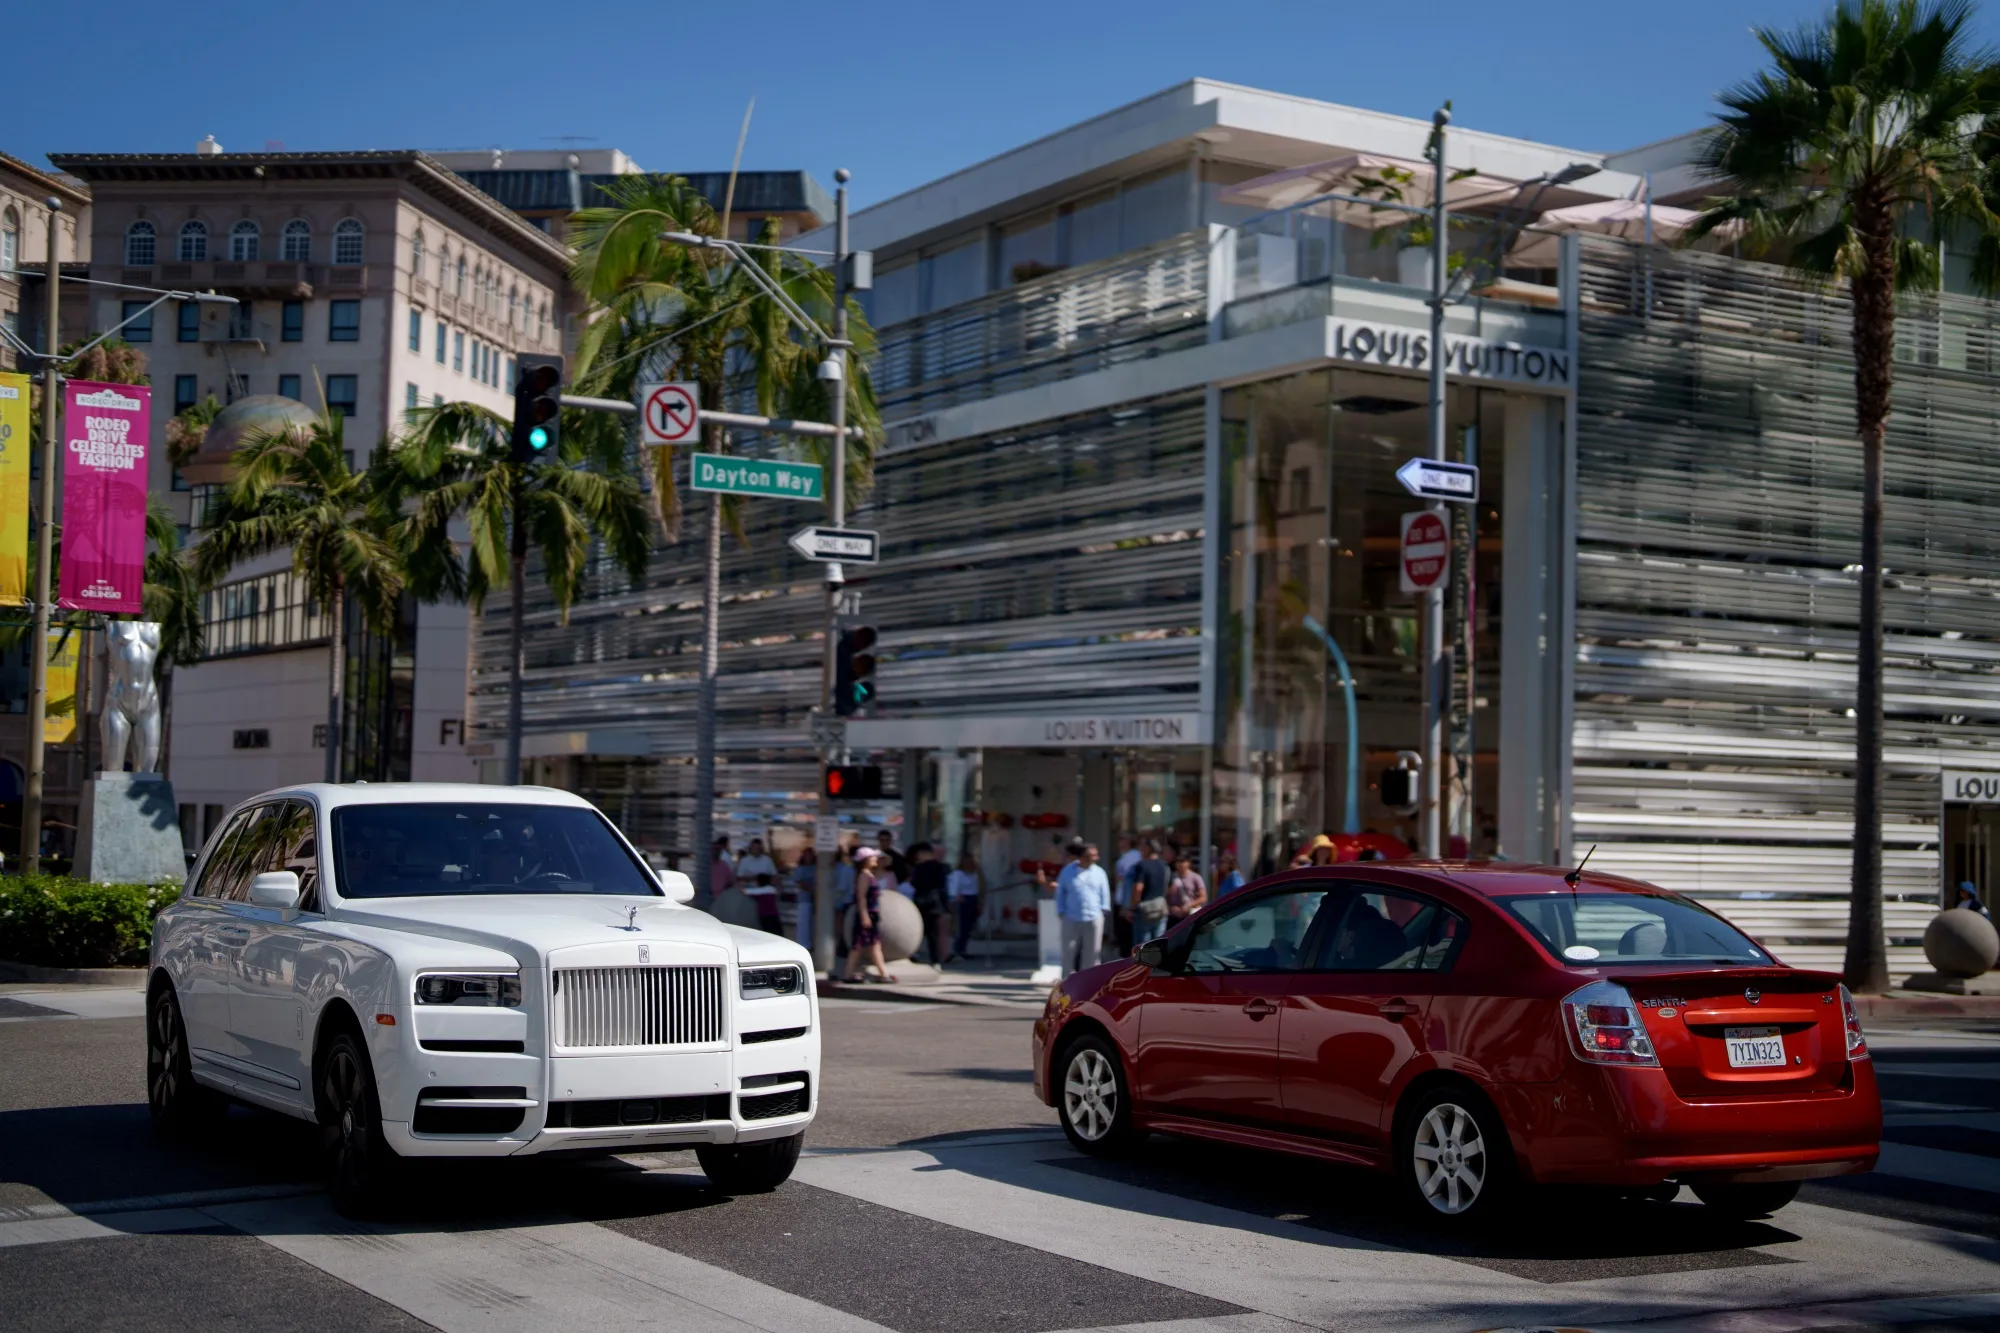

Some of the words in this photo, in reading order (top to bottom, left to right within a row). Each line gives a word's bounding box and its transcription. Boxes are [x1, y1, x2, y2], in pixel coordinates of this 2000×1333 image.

[1335, 323, 1429, 367] LOUIS
[1443, 338, 1570, 382] VUITTON
[85, 415, 131, 432] RODEO
[88, 428, 128, 444] DRIVE
[69, 439, 145, 458] CELEBRATES
[79, 451, 135, 469] FASHION
[701, 463, 771, 488] Dayton
[776, 470, 814, 495] Way
[1422, 470, 1441, 486] ONE
[1447, 475, 1465, 487] WAY
[1410, 528, 1423, 541] DO
[1425, 525, 1442, 539] NOT
[816, 539, 838, 551] ONE
[844, 540, 865, 552] WAY
[1411, 560, 1439, 575] ENTER
[1044, 720, 1096, 741] LOUIS
[1102, 718, 1182, 741] VUITTON
[1955, 776, 1998, 800] LOU
[1642, 998, 1687, 1008] SENTRA
[1730, 1041, 1782, 1062] 7YIN323
